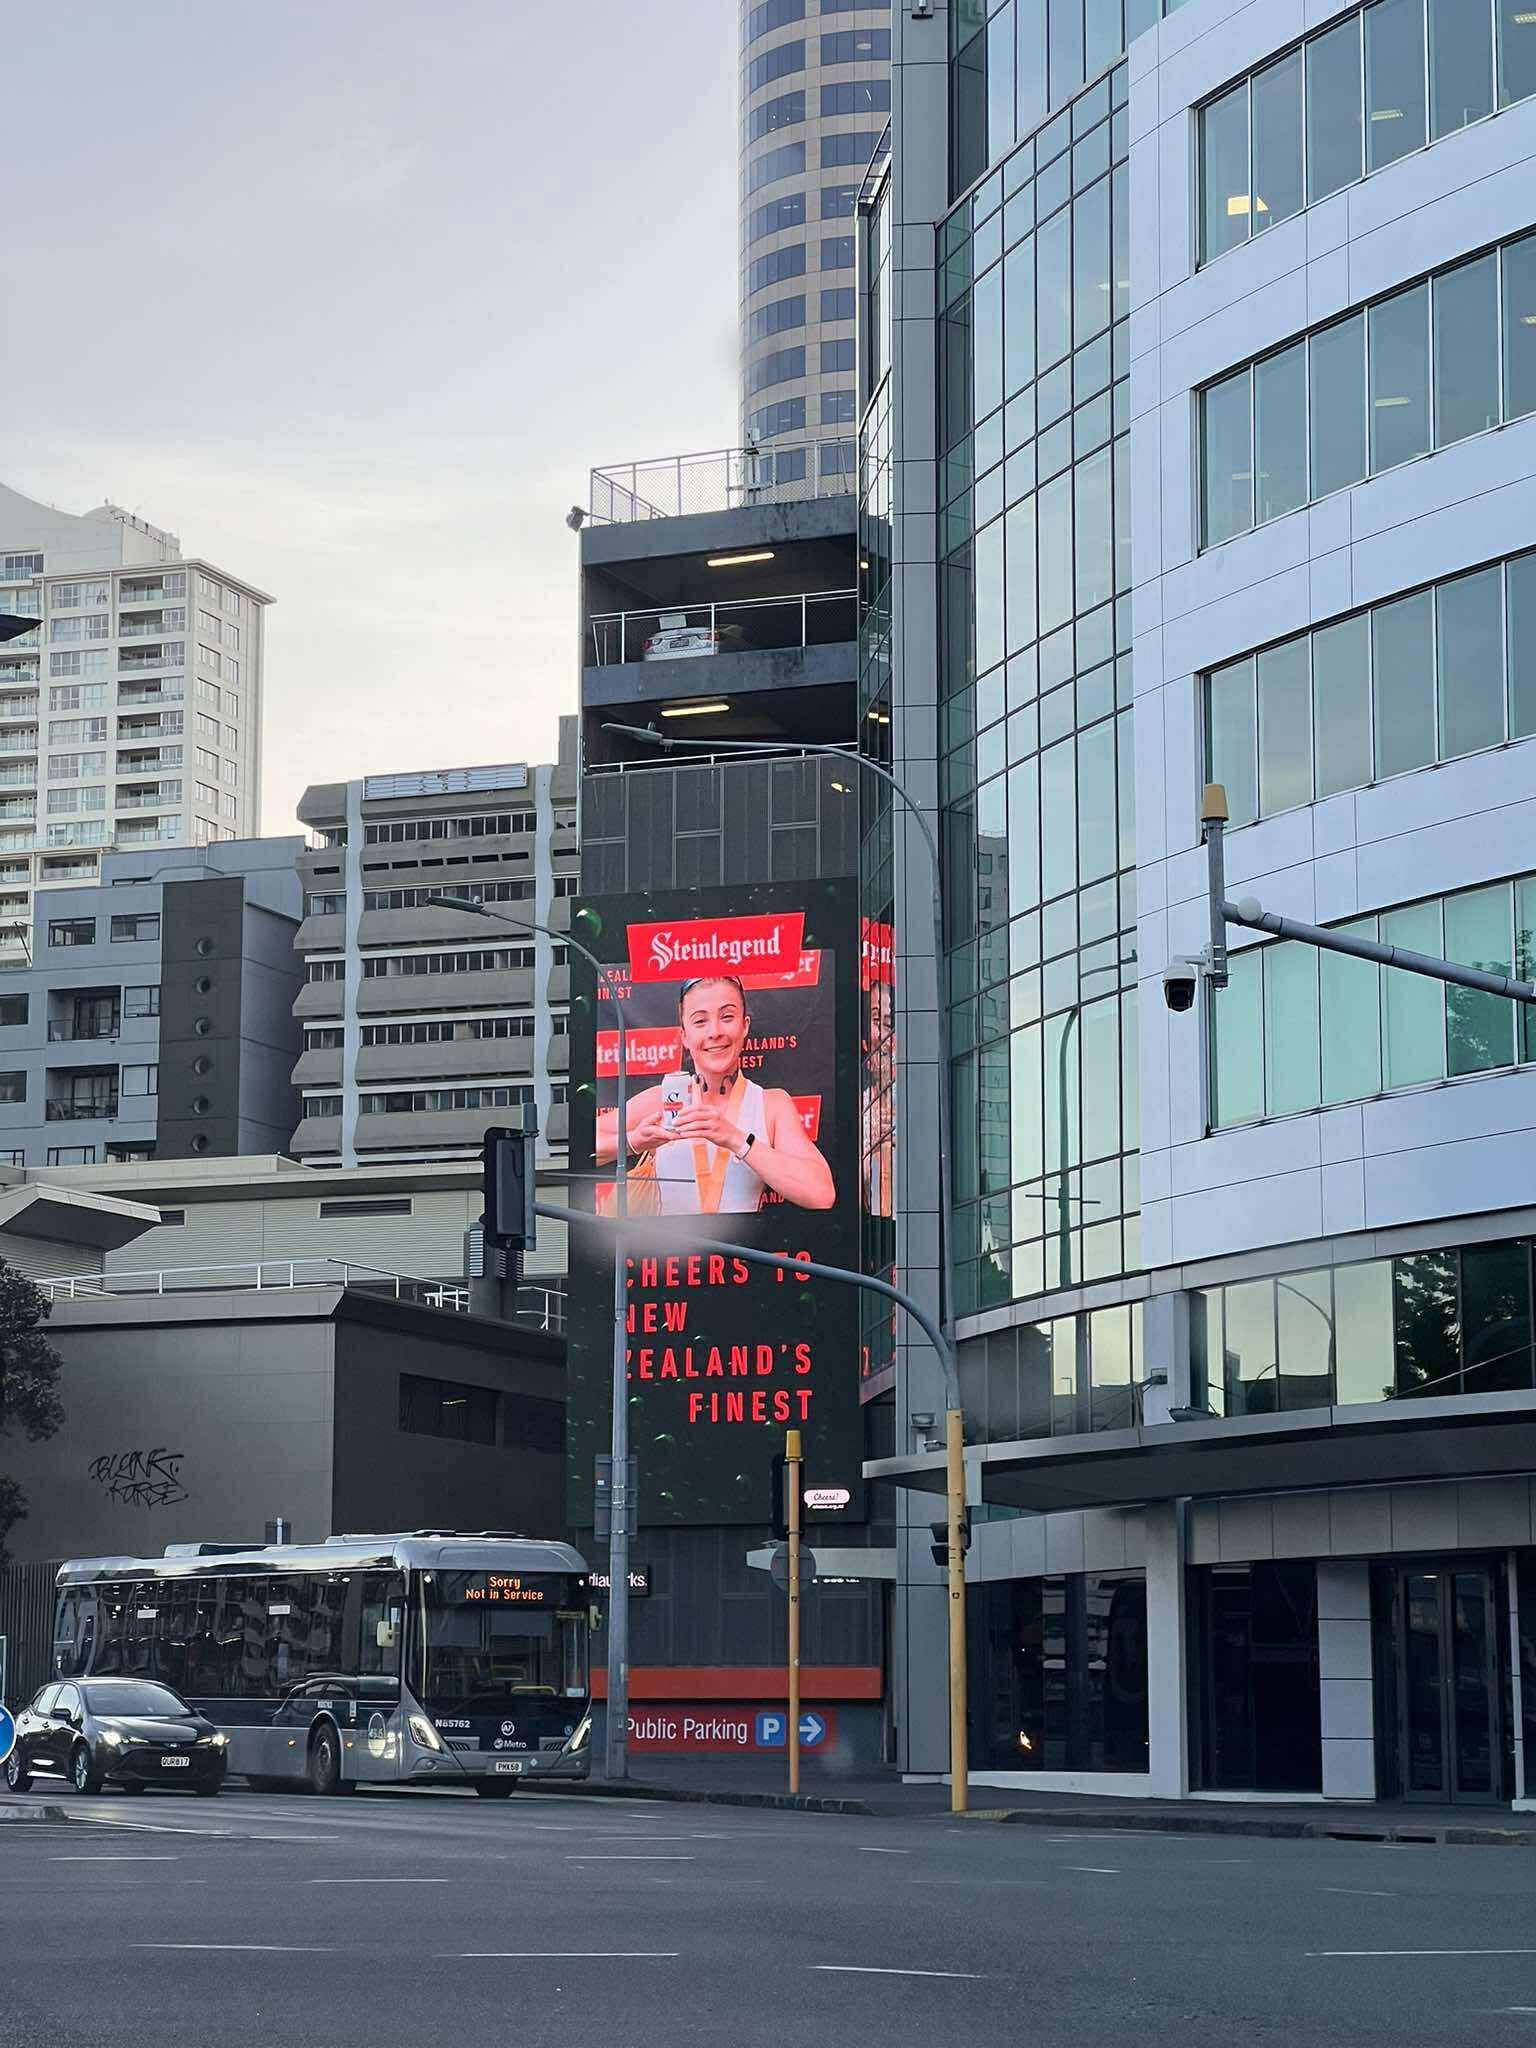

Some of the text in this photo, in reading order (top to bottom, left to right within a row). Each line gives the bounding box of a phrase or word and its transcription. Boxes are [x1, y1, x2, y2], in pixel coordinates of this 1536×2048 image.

[647, 924, 780, 972] Steinlegend
[773, 1250, 811, 1282] TO
[688, 1390, 812, 1422] FINEST
[465, 1588, 544, 1601] Not in Service
[488, 1576, 521, 1590] Sorry
[627, 1718, 677, 1740] Public
[683, 1718, 748, 1744] Parking
[503, 1740, 527, 1749] Metro
